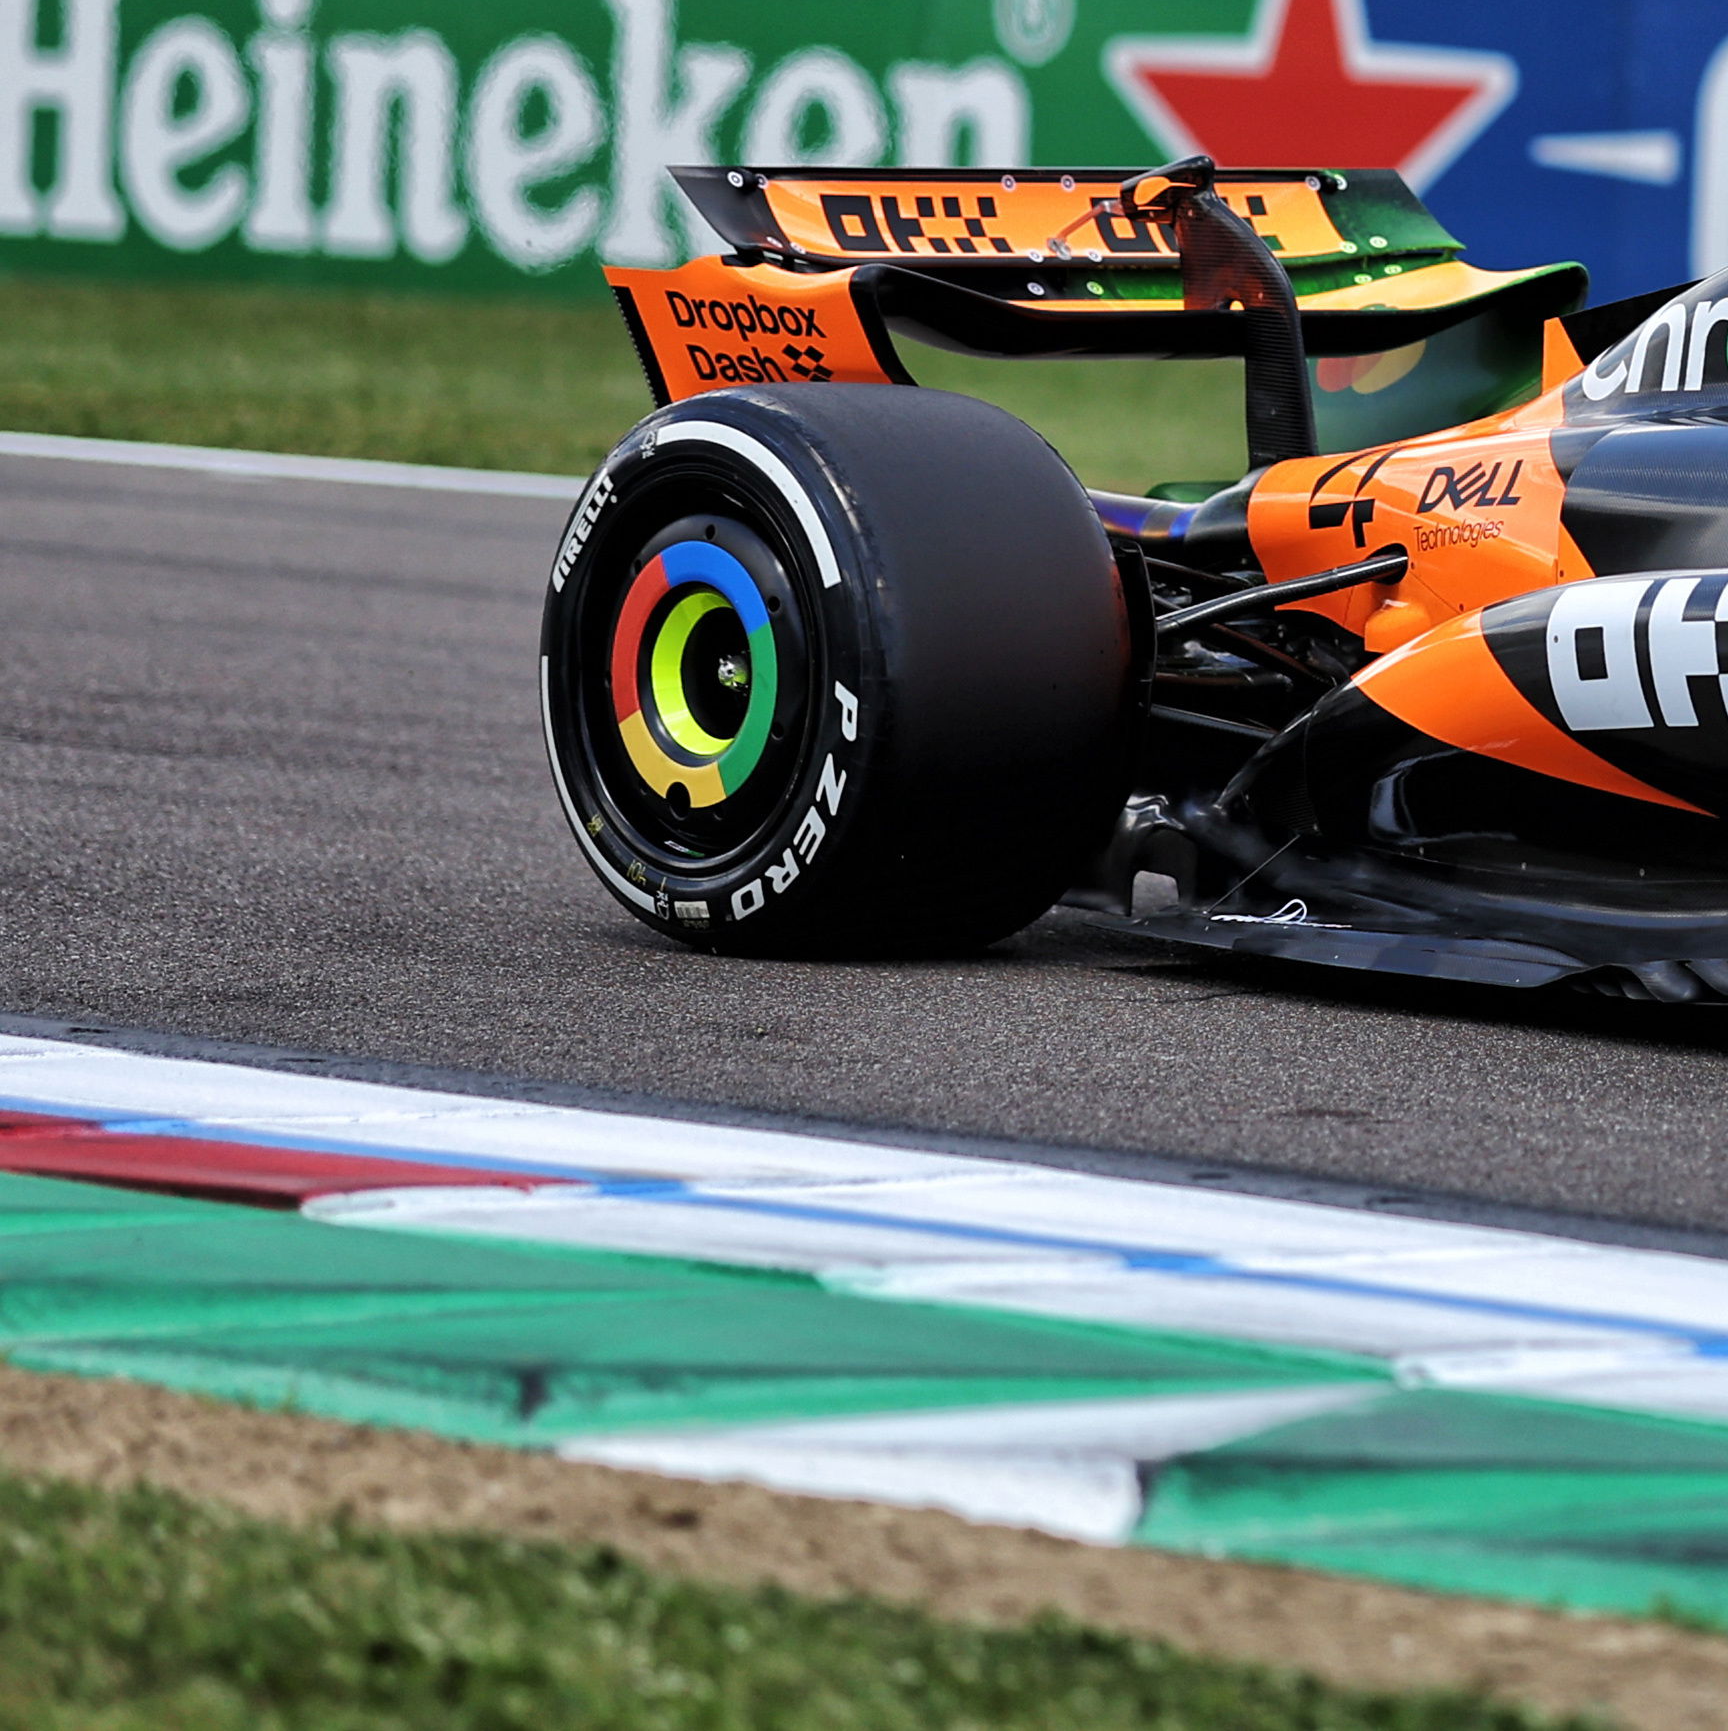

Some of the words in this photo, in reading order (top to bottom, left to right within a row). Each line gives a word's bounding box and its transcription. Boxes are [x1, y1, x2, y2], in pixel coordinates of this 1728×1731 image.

[821, 194, 1012, 253] OKX
[669, 290, 828, 339] Dropbox
[690, 343, 784, 384] Dash
[1416, 459, 1524, 515] DELL
[553, 468, 614, 592] PIRELLI
[1414, 518, 1504, 552] Technologies
[835, 680, 858, 743] P
[731, 753, 847, 921] ZERO
